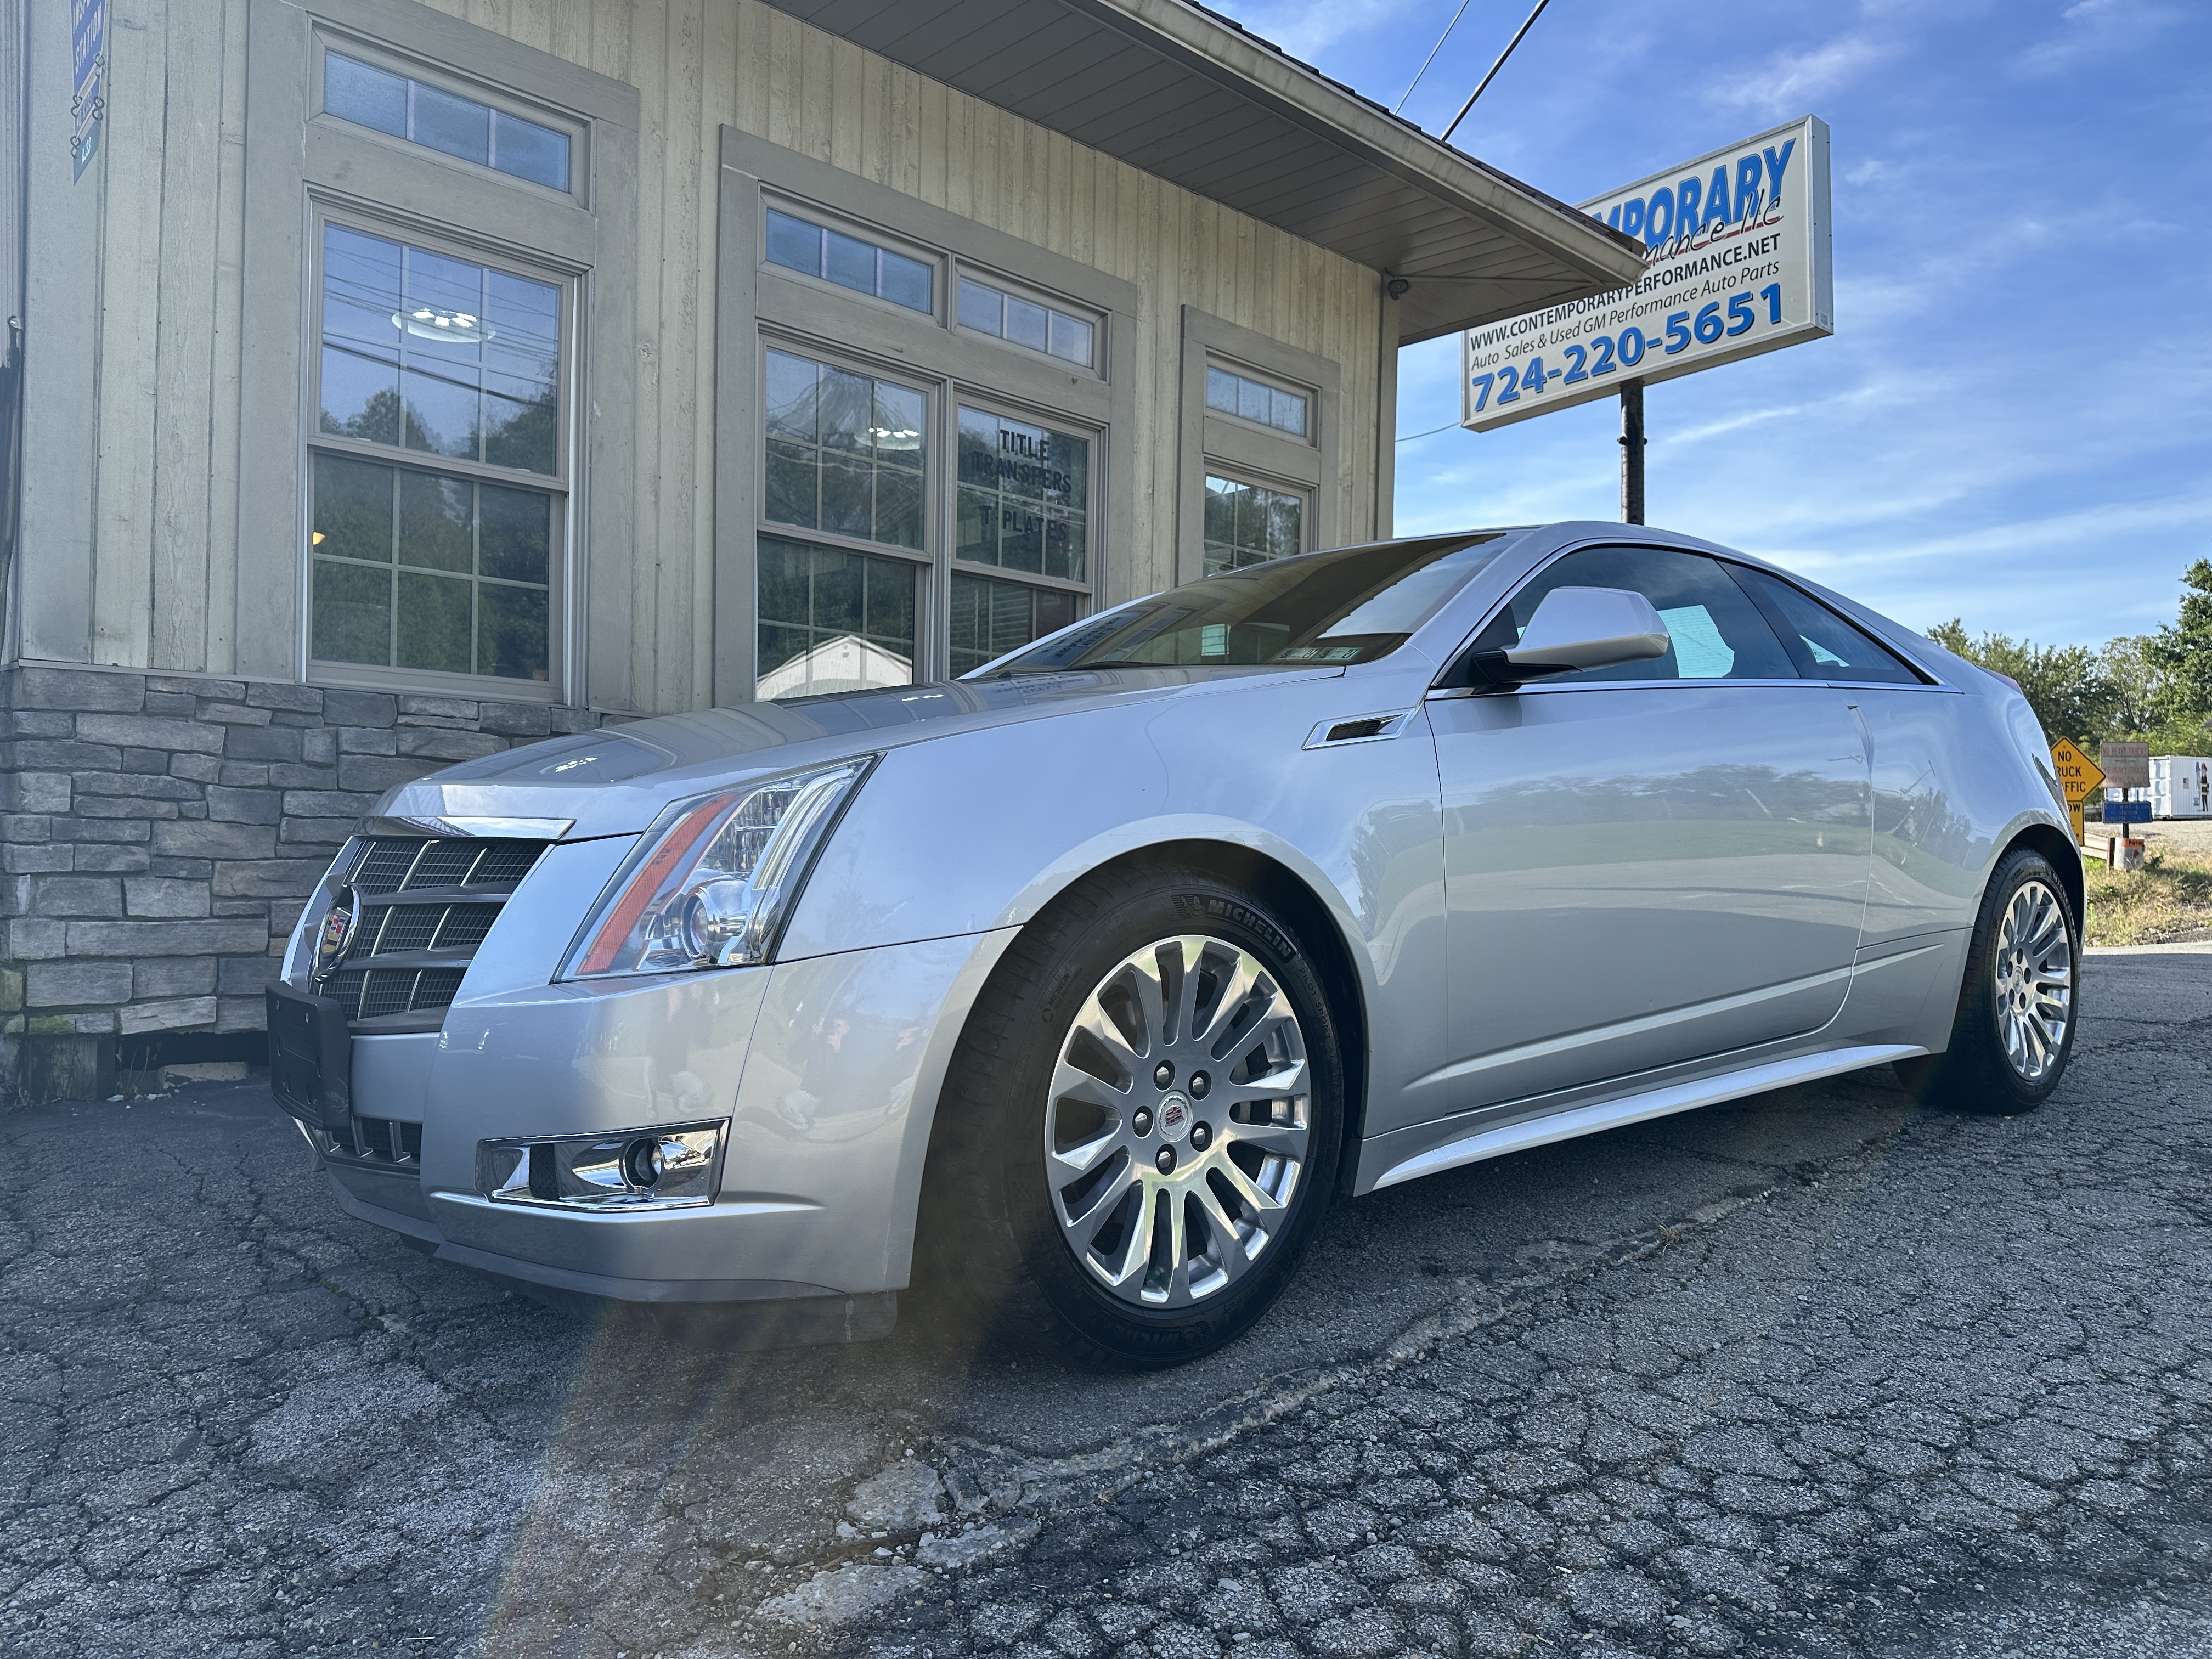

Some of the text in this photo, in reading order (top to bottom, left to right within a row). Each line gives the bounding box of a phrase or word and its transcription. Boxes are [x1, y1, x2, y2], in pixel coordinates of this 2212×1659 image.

[76, 1, 102, 74] STATION
[1471, 233, 1780, 351] WWW.CONTEMPORARYPERFORMANCE.NET
[1471, 261, 1780, 371] Auto Sales & Used GM Performance Auto Parts
[1472, 282, 1781, 412] 724-220-5651
[1000, 428, 1049, 461] TITLE
[971, 450, 1071, 493] TRANSFERS
[2057, 766, 2081, 777] RUCK
[2058, 751, 2072, 762] NO
[2064, 781, 2086, 792] FFIC
[1048, 973, 1070, 1007] MICHELIN
[1208, 899, 1292, 958] MICHELIN
[1299, 967, 1317, 997] PILOT
[1316, 1002, 1332, 1041] SPORT
